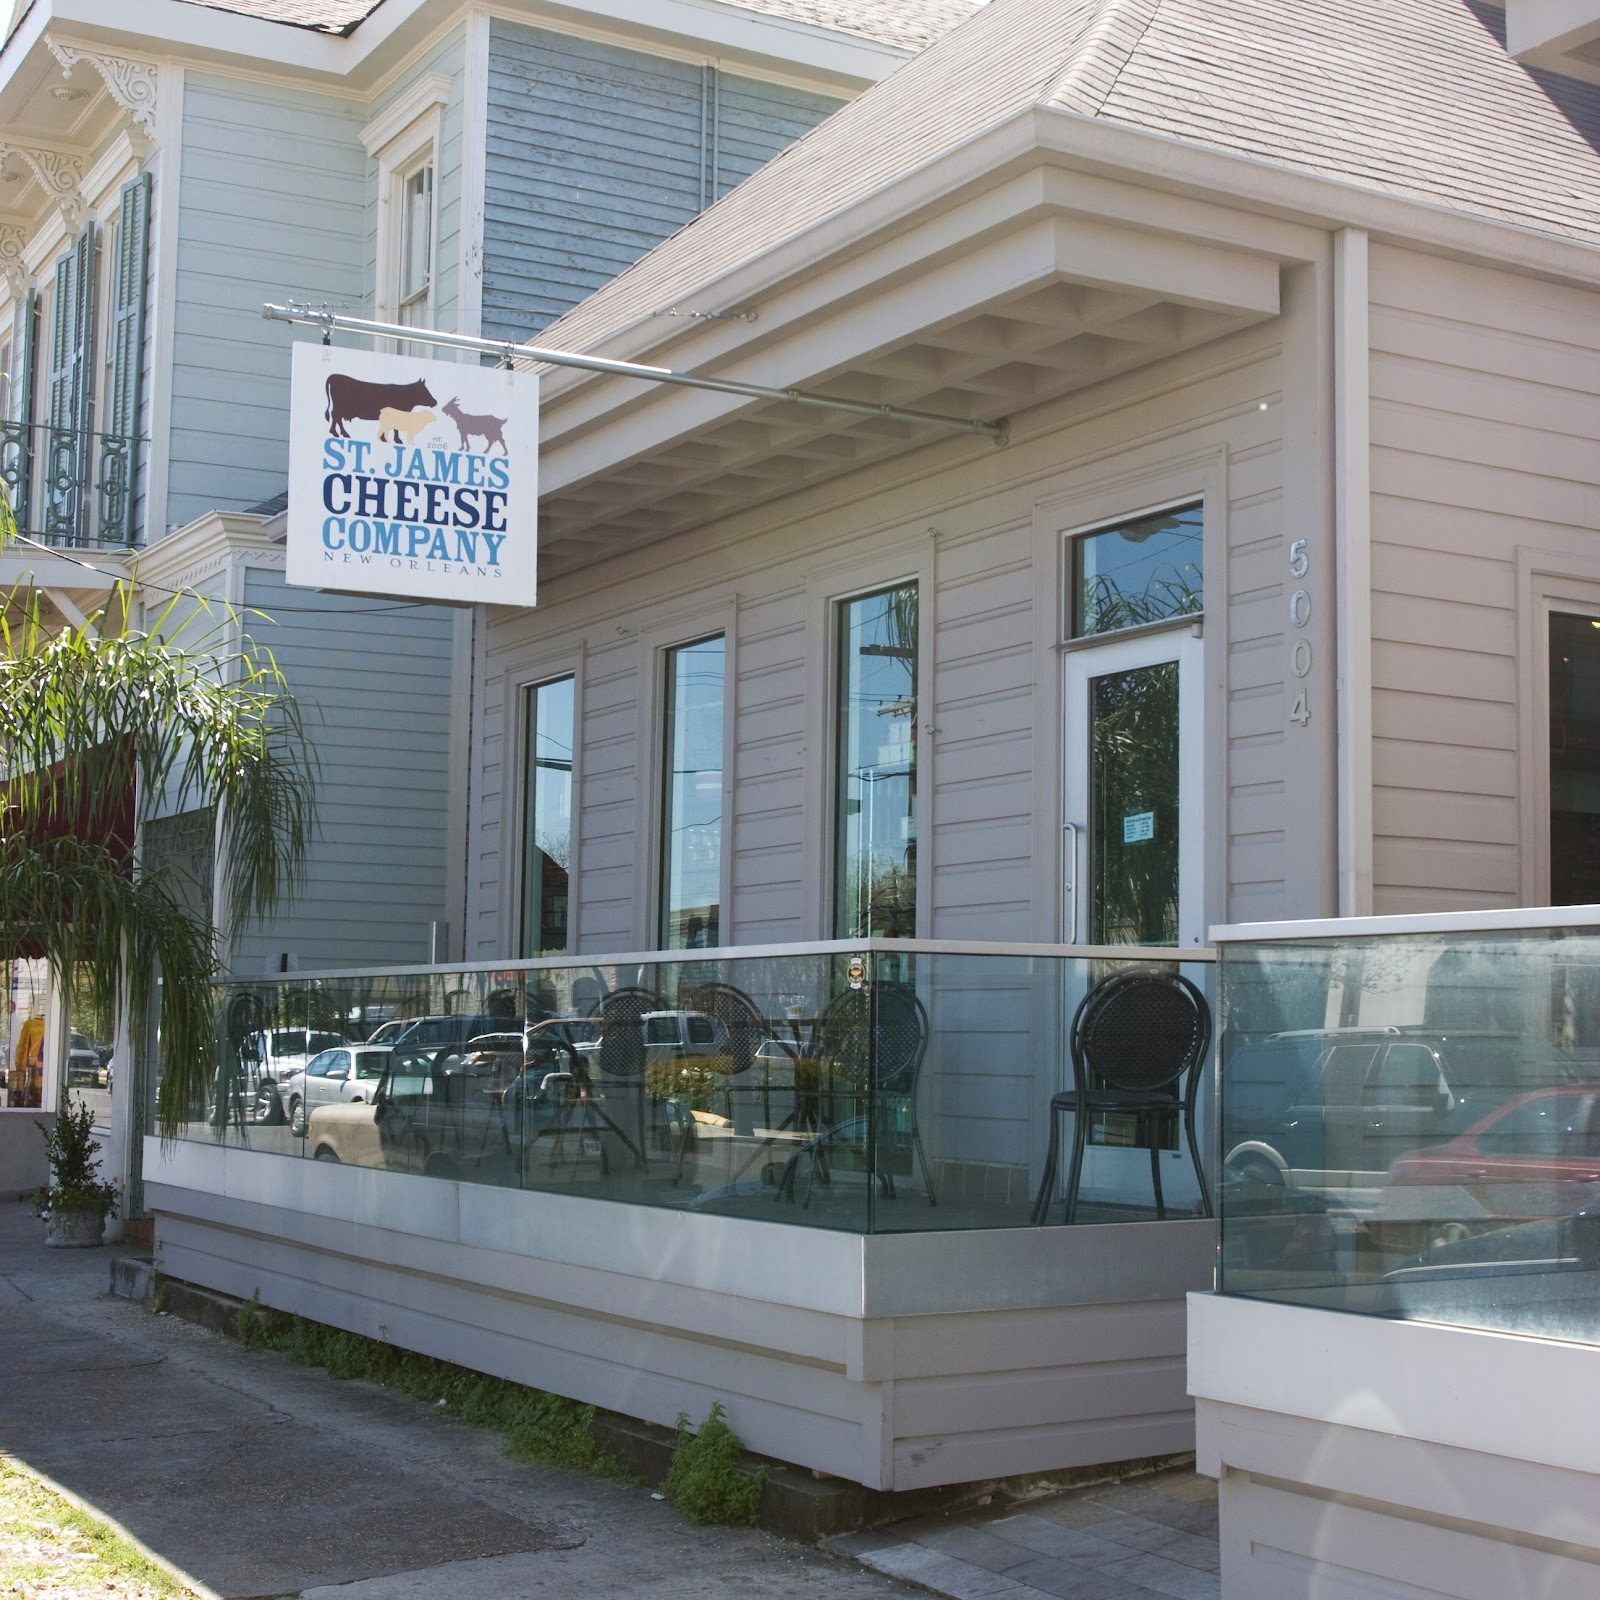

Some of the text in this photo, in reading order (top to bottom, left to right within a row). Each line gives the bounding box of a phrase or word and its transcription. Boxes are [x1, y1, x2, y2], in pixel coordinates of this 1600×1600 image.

[323, 437, 510, 490] ST. JAMES
[322, 472, 508, 532] CHEESE
[322, 516, 507, 567] COMPANY
[323, 551, 503, 579] NEW ORLEANS
[1289, 538, 1313, 728] 5004
